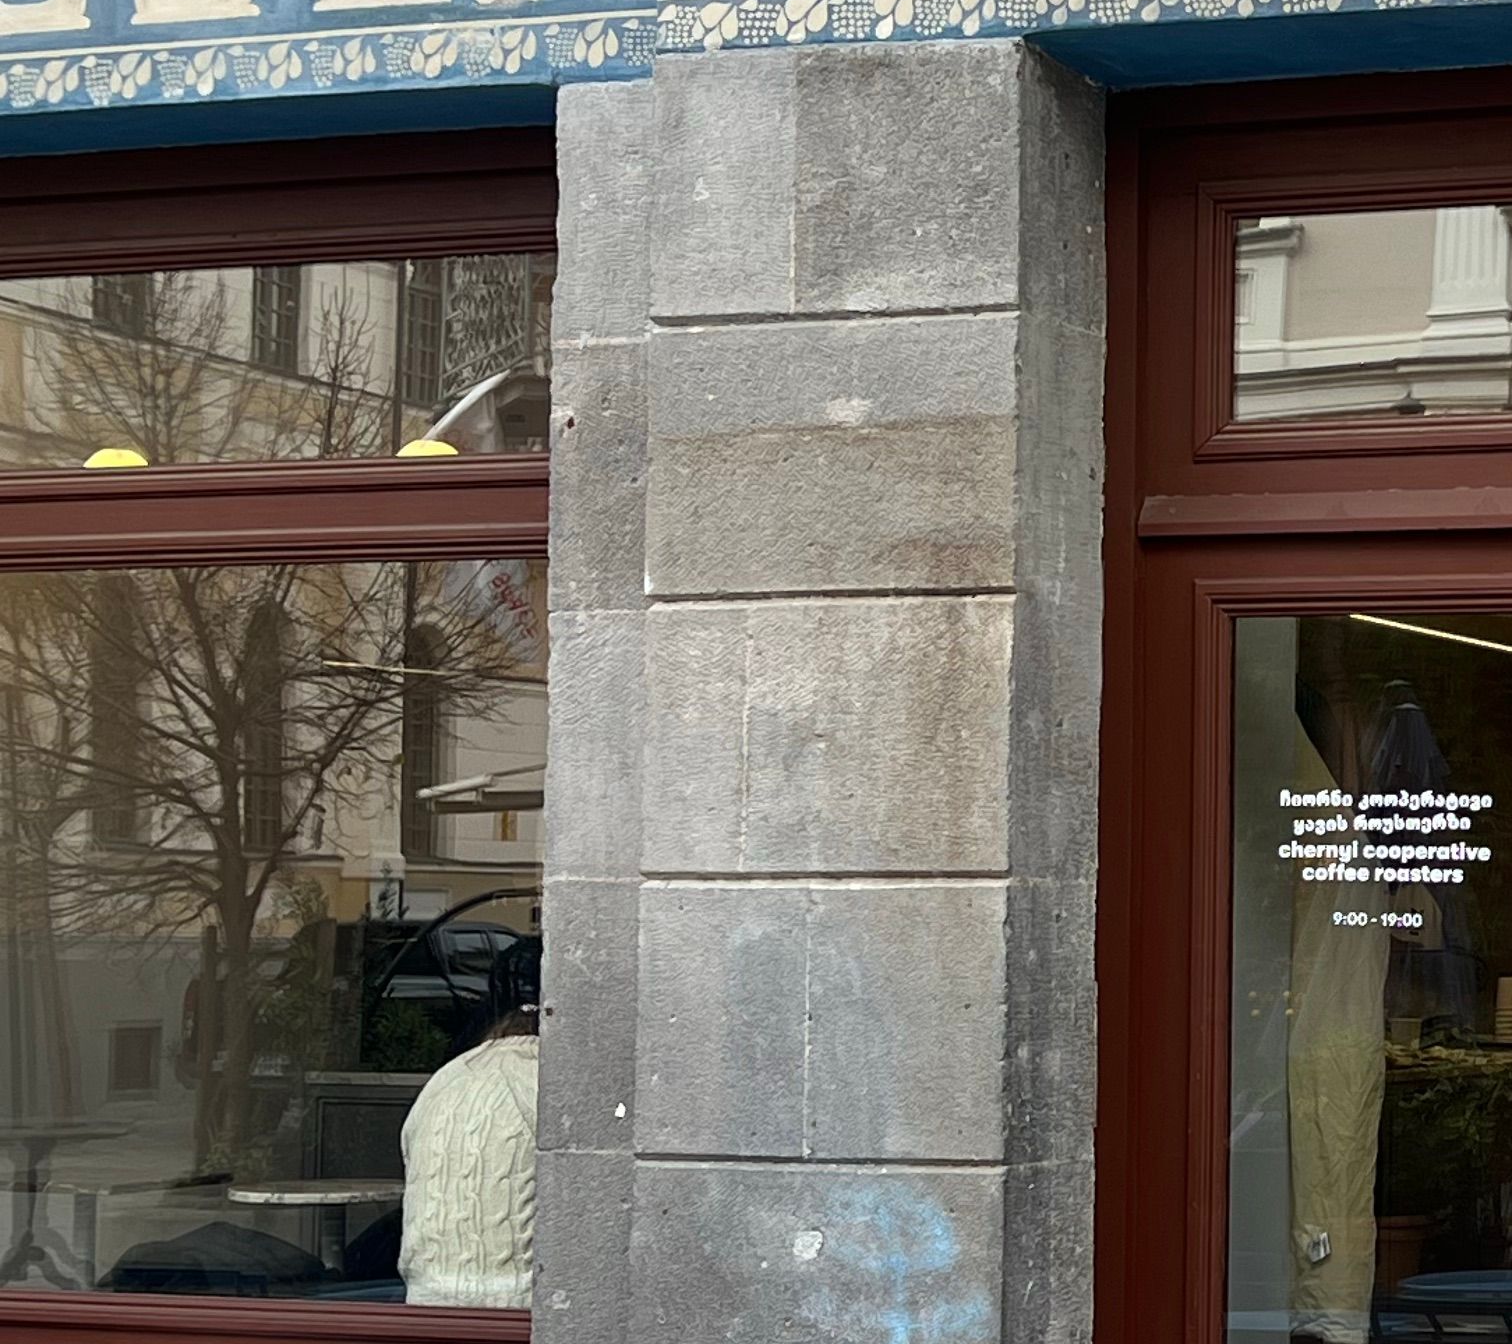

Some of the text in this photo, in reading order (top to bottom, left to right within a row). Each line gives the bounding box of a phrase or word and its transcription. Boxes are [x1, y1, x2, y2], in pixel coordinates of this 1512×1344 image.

[1293, 814, 1348, 835] ყავის
[1362, 842, 1492, 863] cooperative
[1302, 864, 1464, 883] coffee roasters
[1332, 911, 1368, 927] 9:00
[1381, 912, 1424, 928] 19:00
